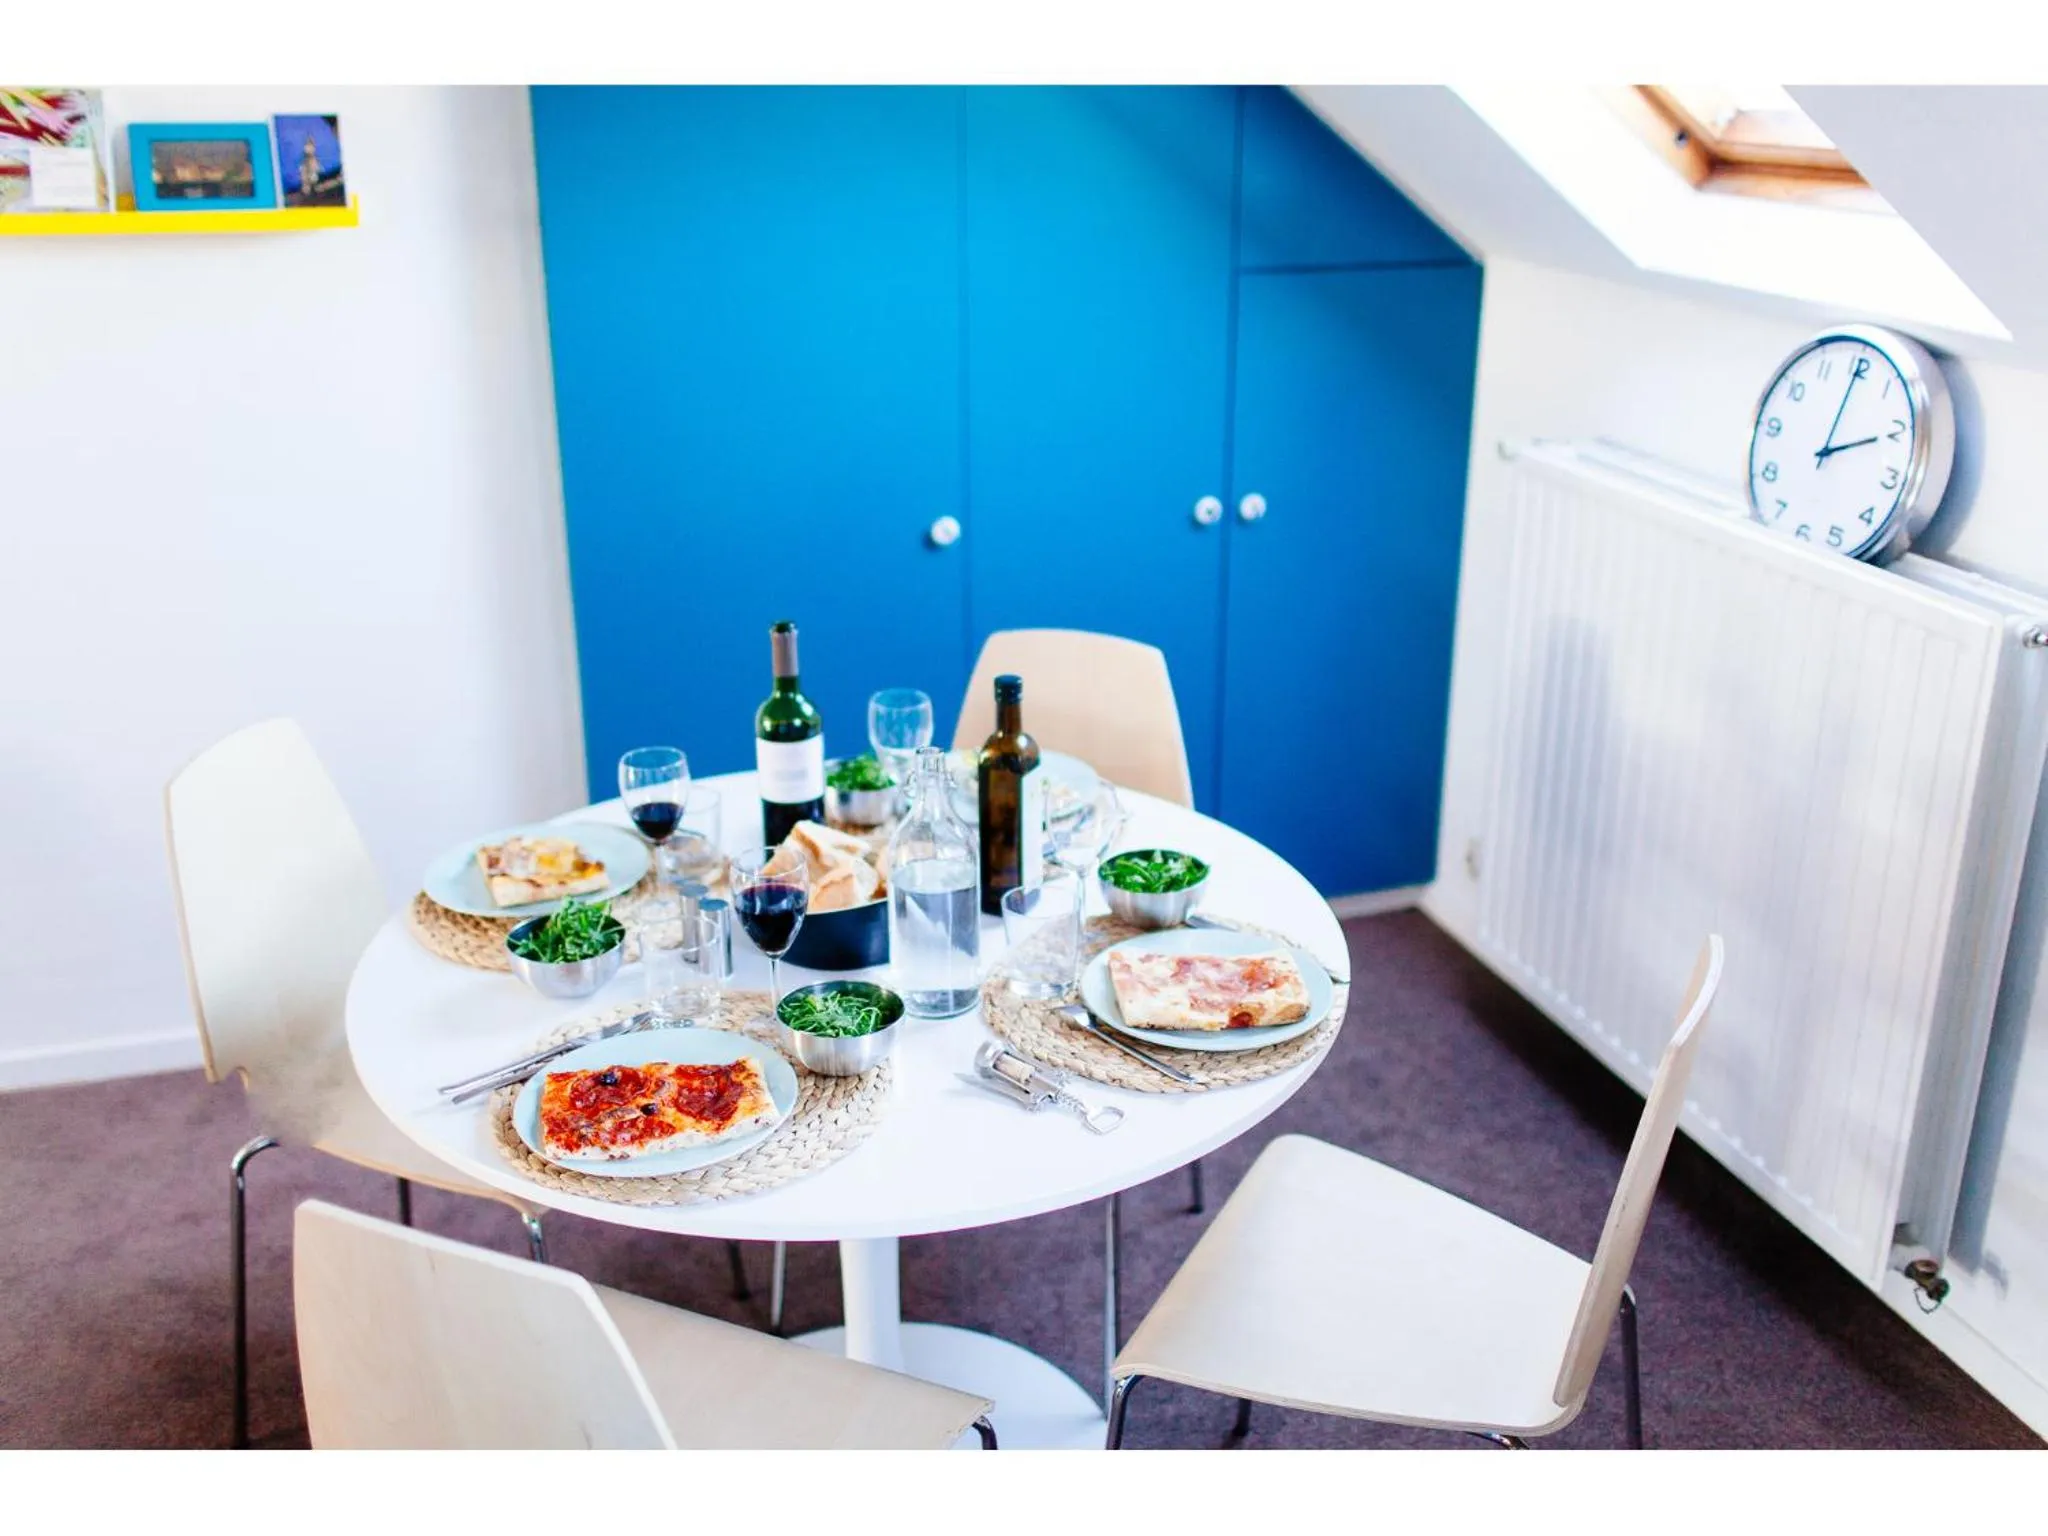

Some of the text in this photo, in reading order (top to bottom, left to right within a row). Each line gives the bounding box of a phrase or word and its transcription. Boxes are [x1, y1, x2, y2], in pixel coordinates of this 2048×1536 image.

[1817, 360, 1832, 381] 11
[1787, 382, 1806, 402] 10
[1882, 379, 1892, 400] 1
[1766, 417, 1782, 438] 9
[1886, 419, 1907, 443] 2
[1761, 461, 1778, 482] 8
[1880, 467, 1900, 490] 3
[1774, 499, 1789, 520] 7
[1858, 506, 1876, 527] 4
[1825, 526, 1845, 547] 5
